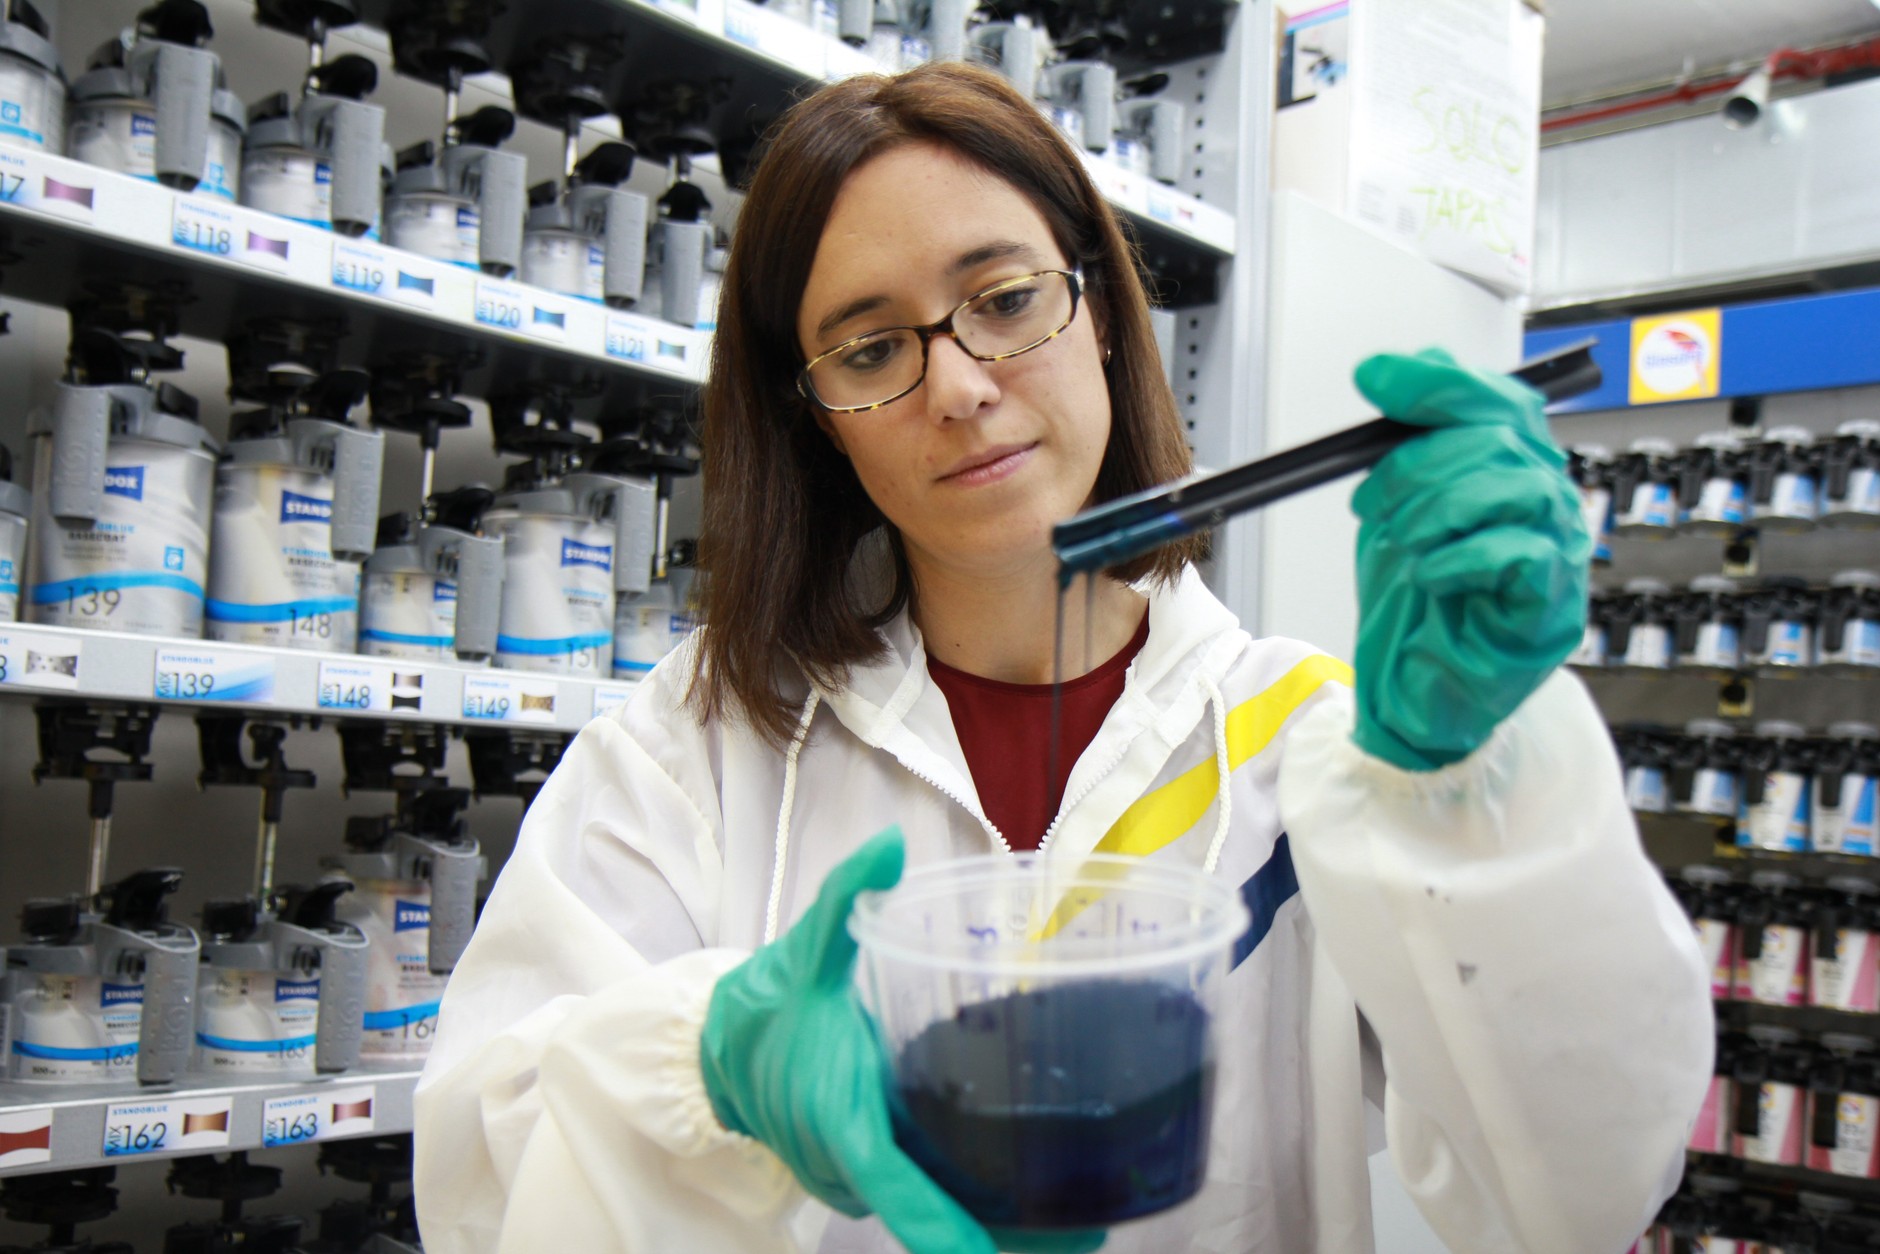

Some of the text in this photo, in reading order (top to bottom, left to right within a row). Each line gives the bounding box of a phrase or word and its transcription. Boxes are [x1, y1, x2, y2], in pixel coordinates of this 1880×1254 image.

[1407, 85, 1526, 174] SOLO
[1407, 186, 1516, 254] TAPAS
[194, 222, 231, 255] 118
[351, 264, 384, 293] 119
[488, 301, 521, 329] 120
[618, 335, 645, 361] 121
[66, 585, 121, 617] 139
[289, 607, 333, 639] 148
[172, 672, 215, 698] 139
[334, 683, 371, 709] 148
[477, 696, 510, 717] 149
[105, 1047, 134, 1067] 162
[113, 1105, 168, 1116] STANDOBLUE
[108, 1122, 168, 1152] MIX 162
[279, 1112, 318, 1141] 163
